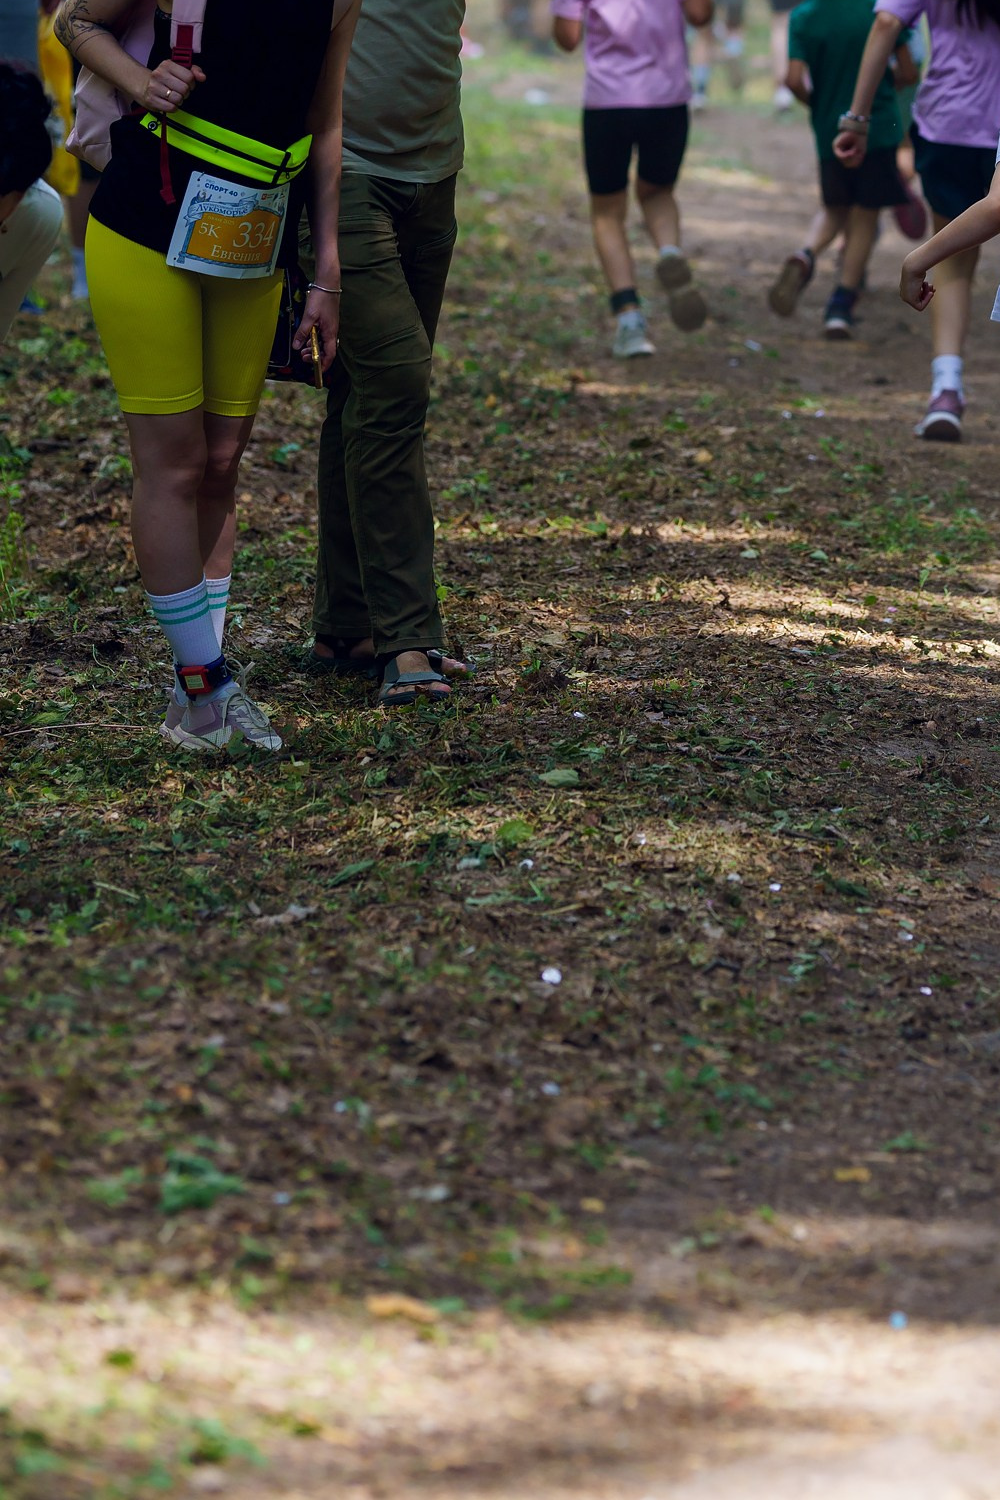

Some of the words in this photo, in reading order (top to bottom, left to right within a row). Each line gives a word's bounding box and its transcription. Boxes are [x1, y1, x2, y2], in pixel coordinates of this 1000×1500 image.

[204, 183, 228, 194] СПОРТ
[196, 204, 248, 217] Лукоморье
[233, 221, 275, 248] 334
[211, 244, 262, 262] Евгения
